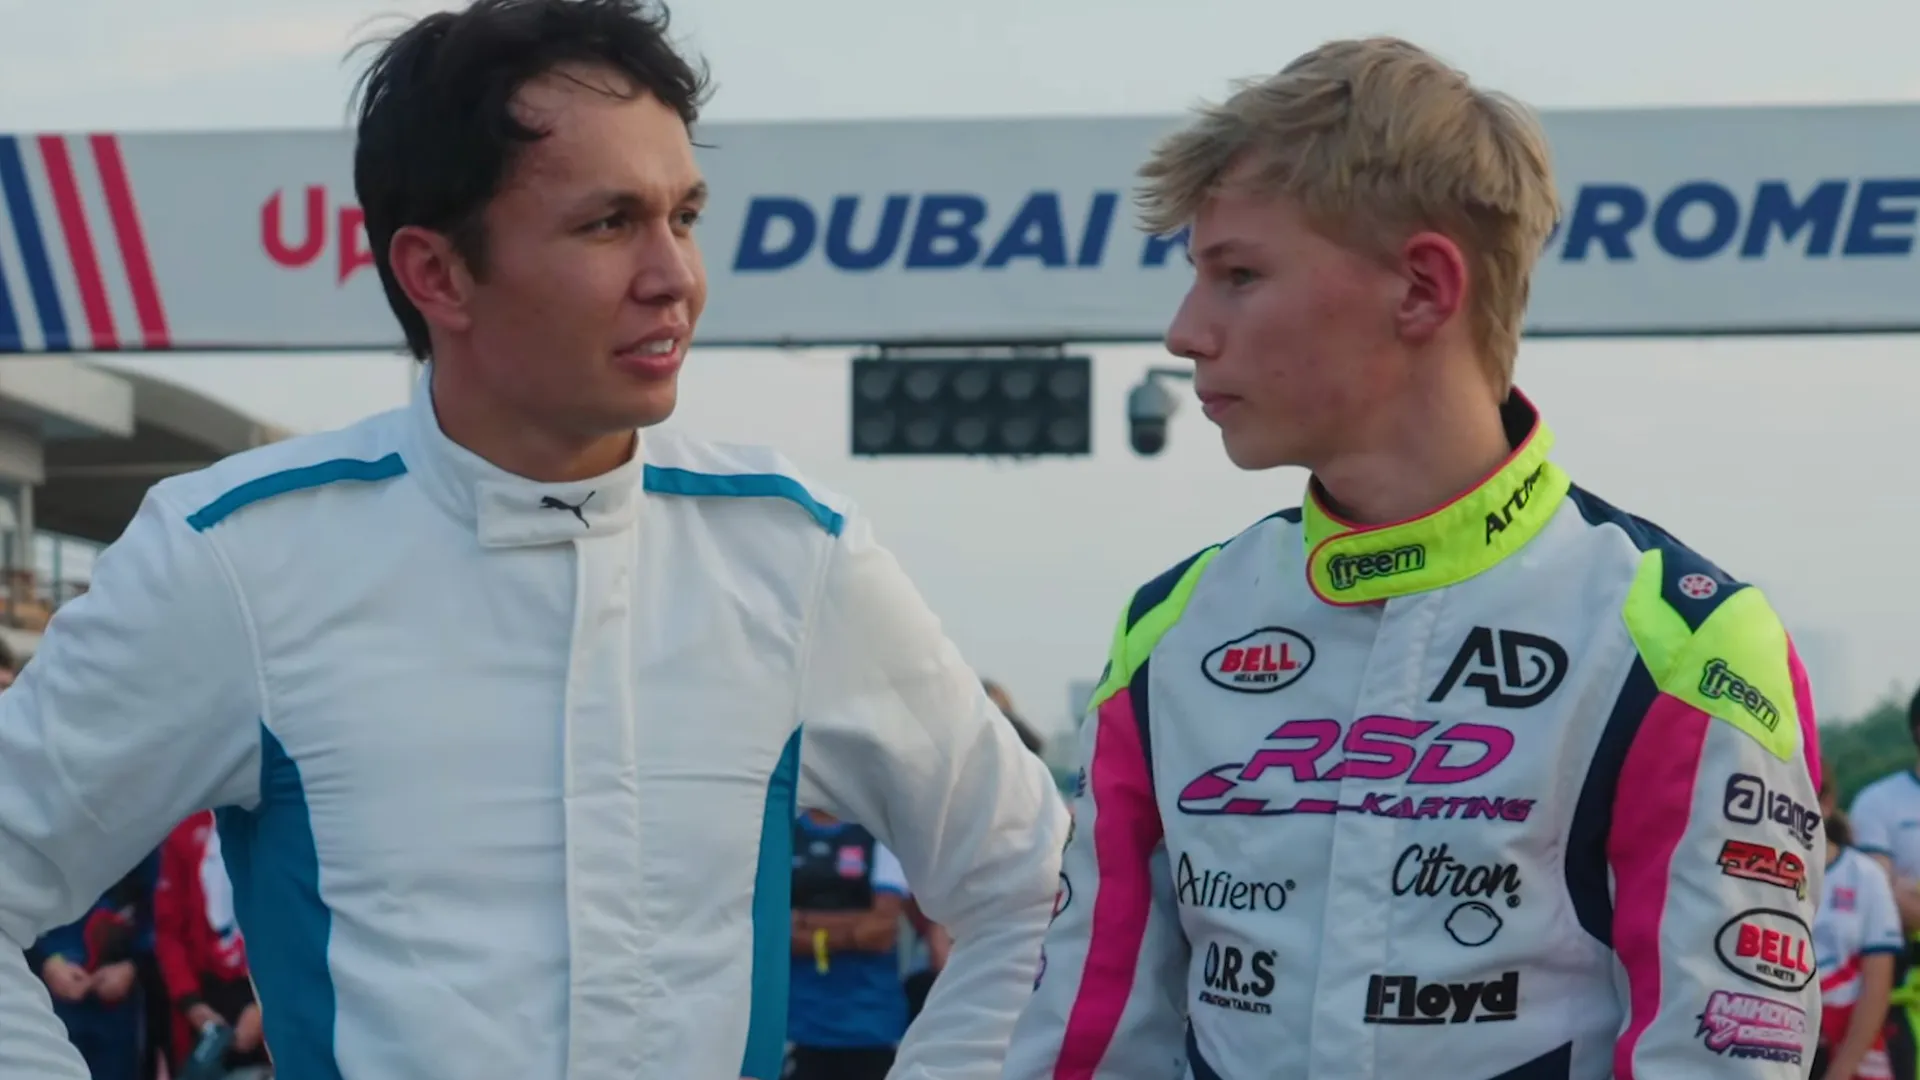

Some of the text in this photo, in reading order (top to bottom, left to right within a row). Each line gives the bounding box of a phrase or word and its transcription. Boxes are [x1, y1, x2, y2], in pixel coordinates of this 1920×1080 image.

[732, 192, 1119, 272] DUBAI
[1327, 545, 1425, 590] freem
[1219, 642, 1297, 672] BELL
[1699, 658, 1779, 732] freem
[1238, 715, 1516, 784] RSD
[1360, 792, 1537, 822] KARTING
[1178, 852, 1286, 911] Alfiero
[1392, 843, 1520, 898] Citron
[1735, 922, 1809, 974] BELL
[1366, 971, 1519, 1024] Floyd
